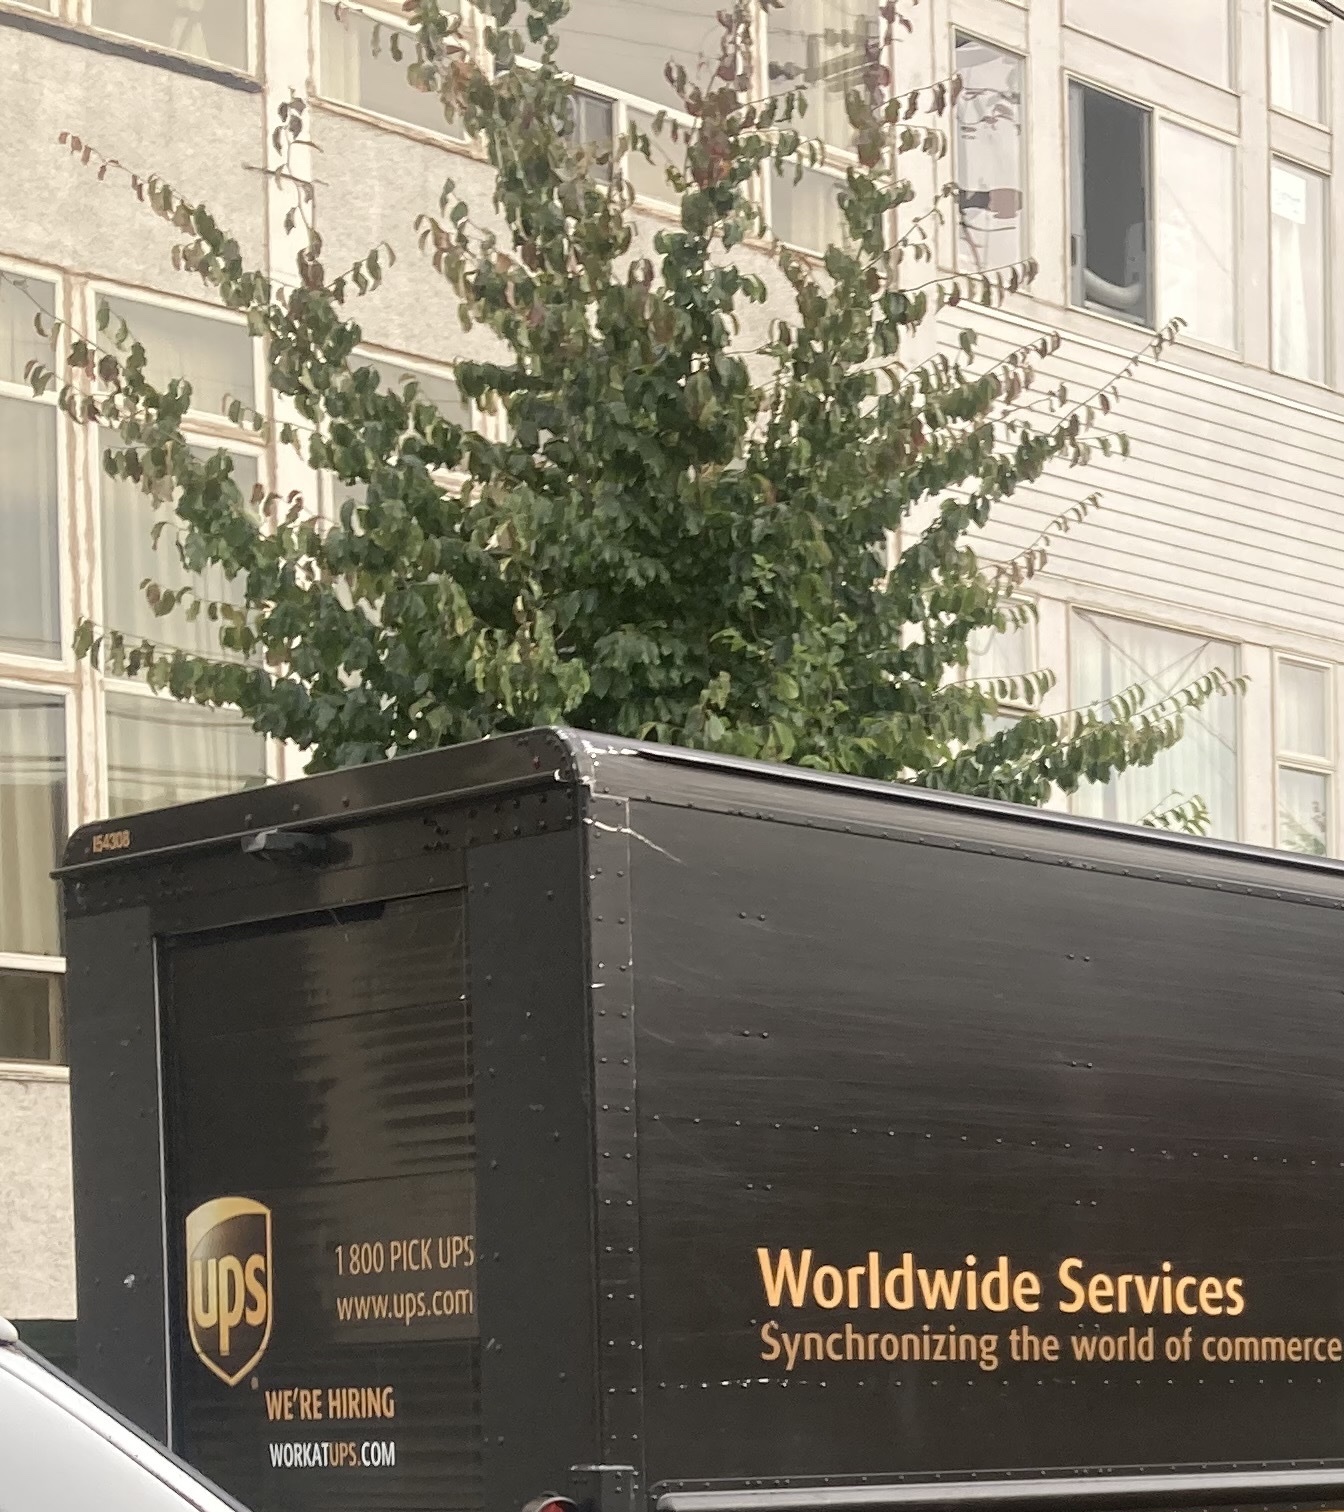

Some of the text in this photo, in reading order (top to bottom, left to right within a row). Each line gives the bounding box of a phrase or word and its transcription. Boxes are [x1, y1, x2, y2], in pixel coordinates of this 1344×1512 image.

[335, 1235, 475, 1276] 1 800 PICK UPS
[757, 1247, 1245, 1316] Worldwide Services
[193, 1253, 267, 1356] ups
[336, 1288, 474, 1327] www.ups.com
[760, 1323, 1343, 1371] Synchronizing the world of commerce
[265, 1386, 395, 1421] WE'RE HIRING
[269, 1441, 396, 1468] WORKATUPS.COM
